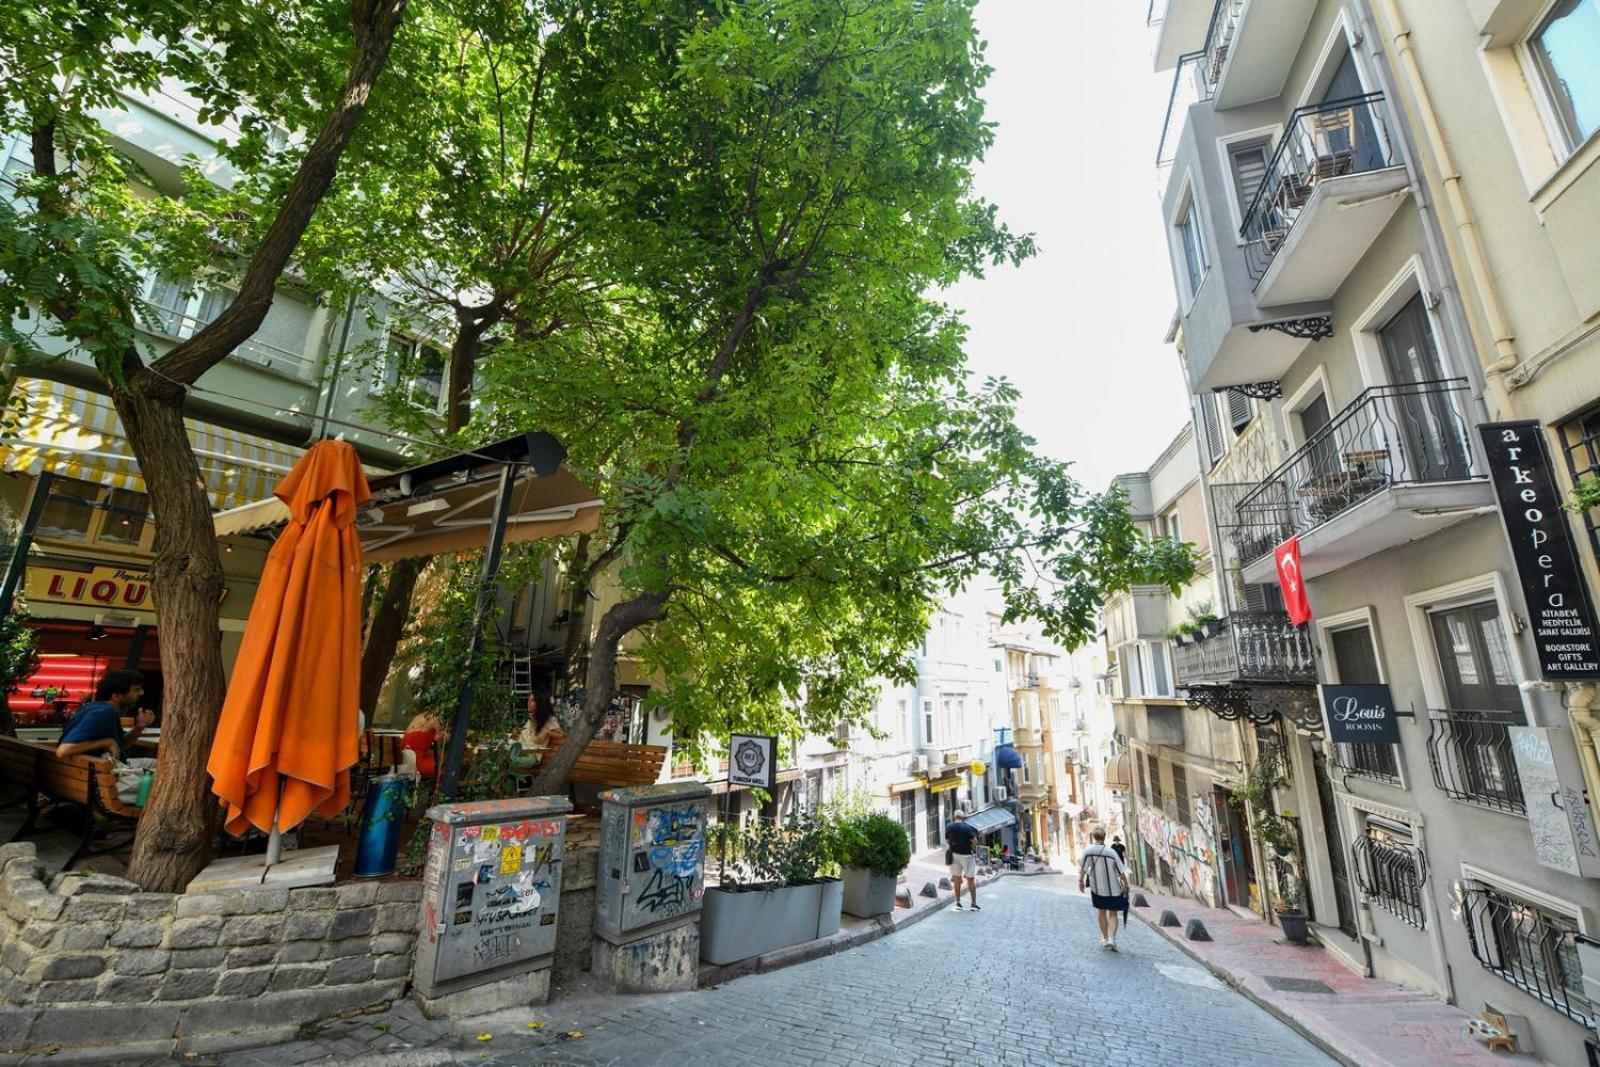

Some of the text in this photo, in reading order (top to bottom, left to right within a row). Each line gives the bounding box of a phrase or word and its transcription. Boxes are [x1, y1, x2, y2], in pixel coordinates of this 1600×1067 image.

[1501, 428, 1564, 607] arkeopera
[1537, 627, 1560, 636] SANAT
[1545, 643, 1592, 652] BOOKSTORE
[1558, 653, 1583, 661] GIFTS
[1547, 662, 1599, 671] ART GALLERY
[1332, 696, 1386, 721] Louis
